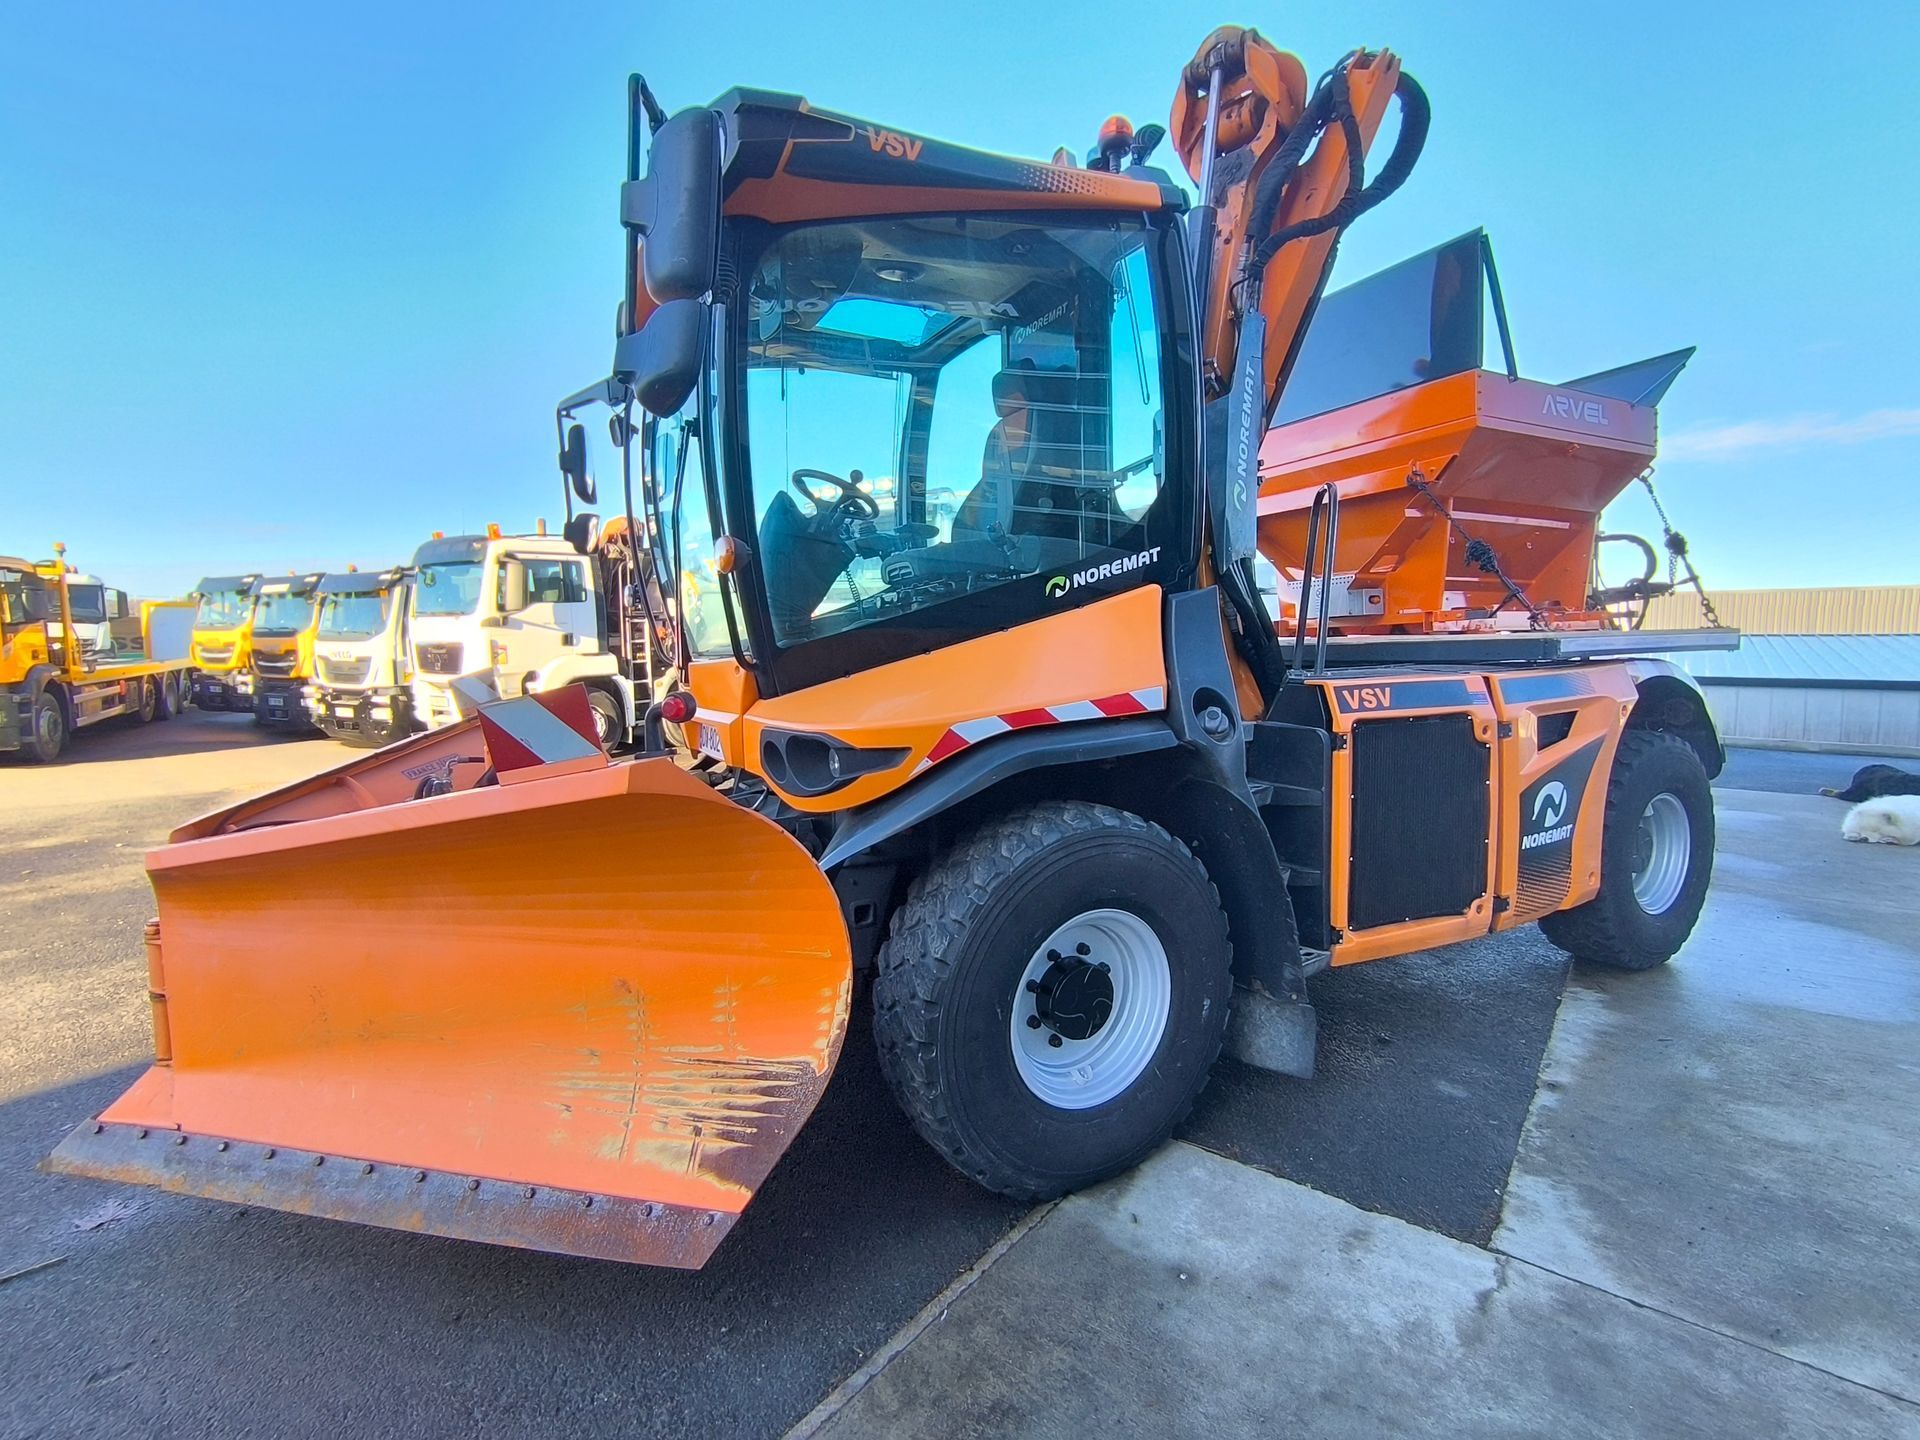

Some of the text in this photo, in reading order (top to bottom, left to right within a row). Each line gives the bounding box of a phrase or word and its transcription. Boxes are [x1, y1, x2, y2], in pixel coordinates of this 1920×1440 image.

[866, 126, 923, 161] VSV
[1025, 302, 1068, 336] NOREMAT
[1237, 360, 1256, 478] NOREMAT
[1542, 394, 1609, 425] ARVEL
[1073, 546, 1161, 588] NOREMAT
[1342, 687, 1391, 710] VSV
[1522, 824, 1573, 850] NOREMAT
